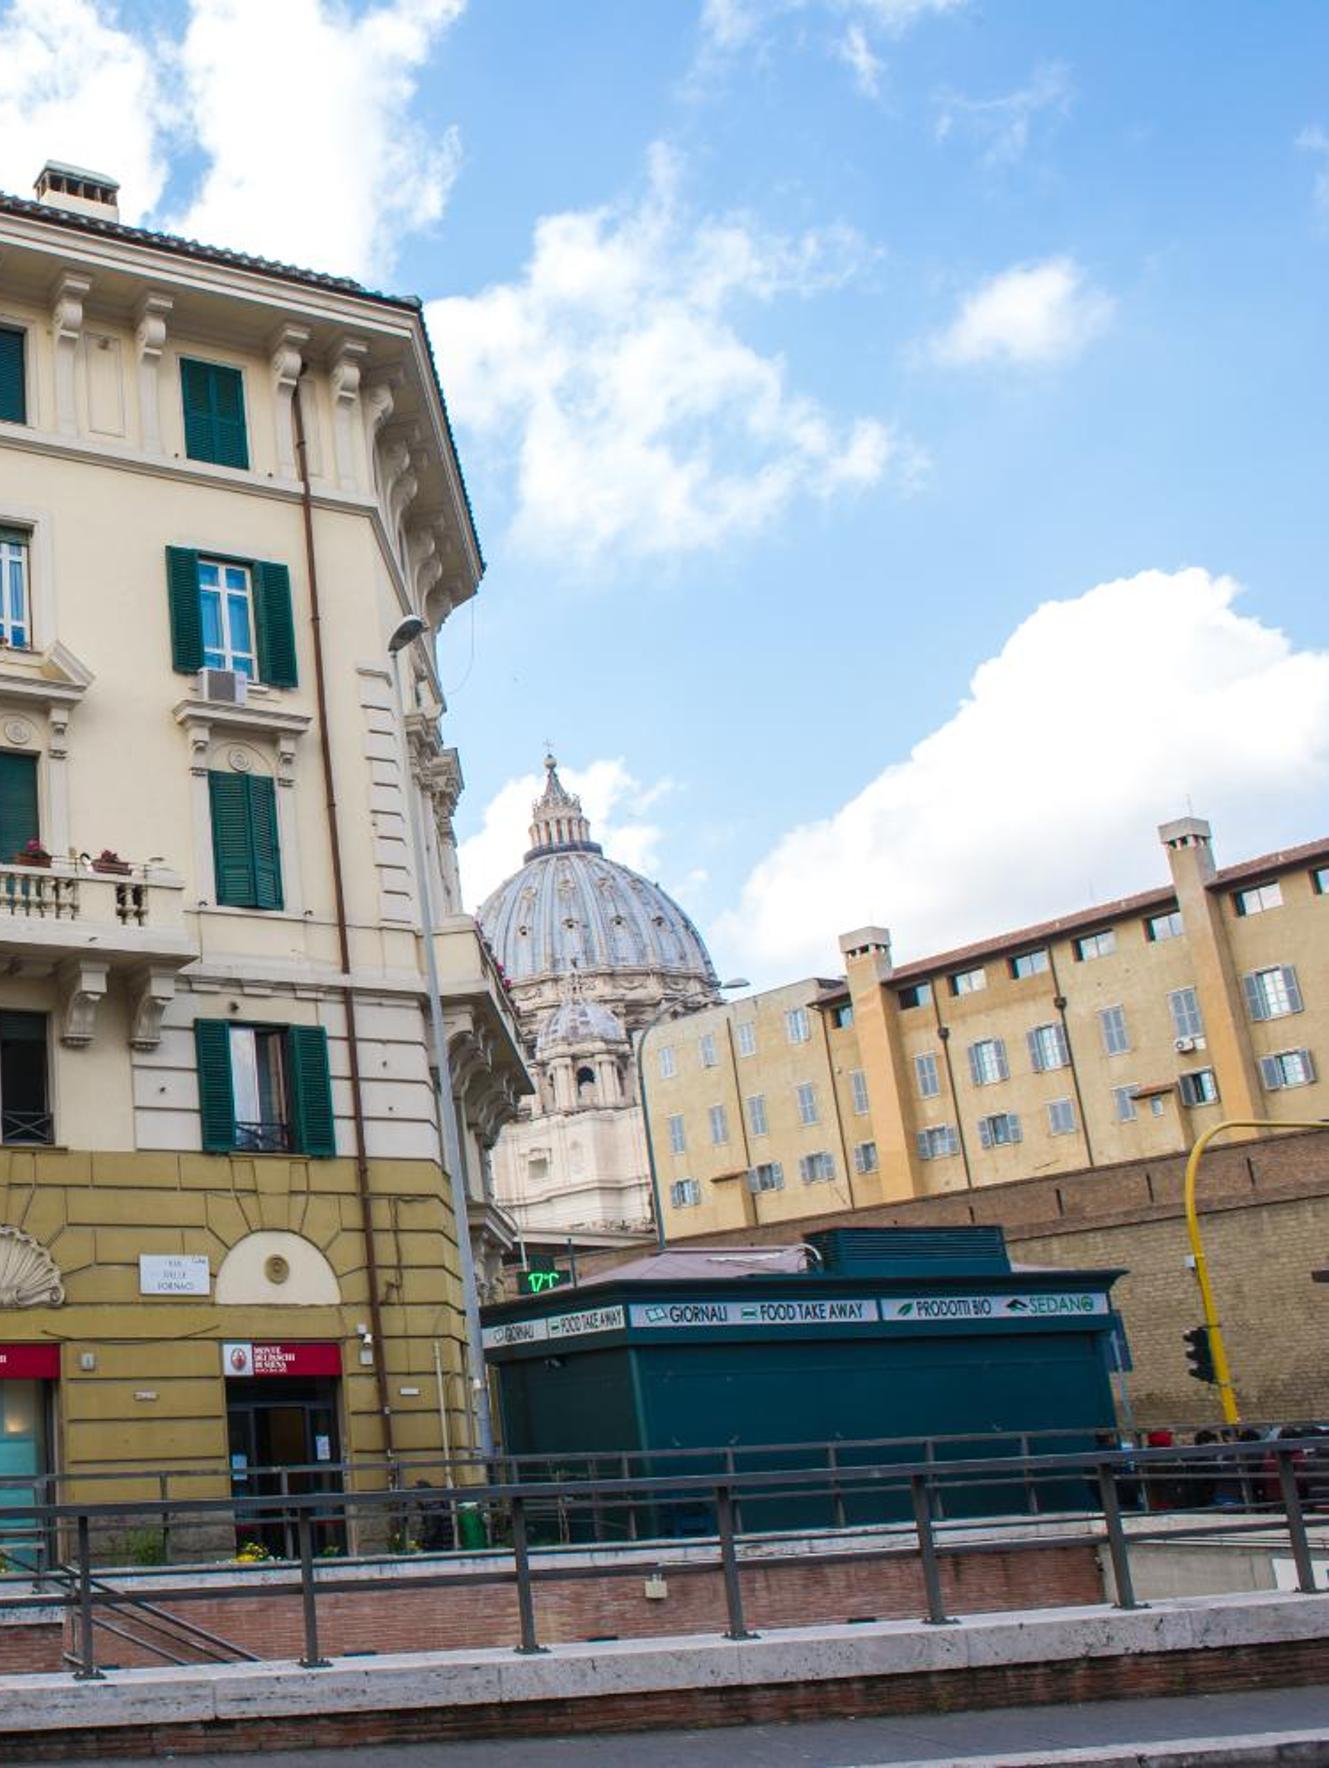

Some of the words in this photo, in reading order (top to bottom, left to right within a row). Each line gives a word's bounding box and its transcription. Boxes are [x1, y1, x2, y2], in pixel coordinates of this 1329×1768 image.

[669, 1305, 728, 1322] GIORNALI
[760, 1306, 796, 1322] FOOD
[797, 1304, 826, 1320] TAKE
[828, 1303, 864, 1320] AWAY
[916, 1300, 971, 1317] PRODOTTI
[972, 1299, 992, 1316] BIO
